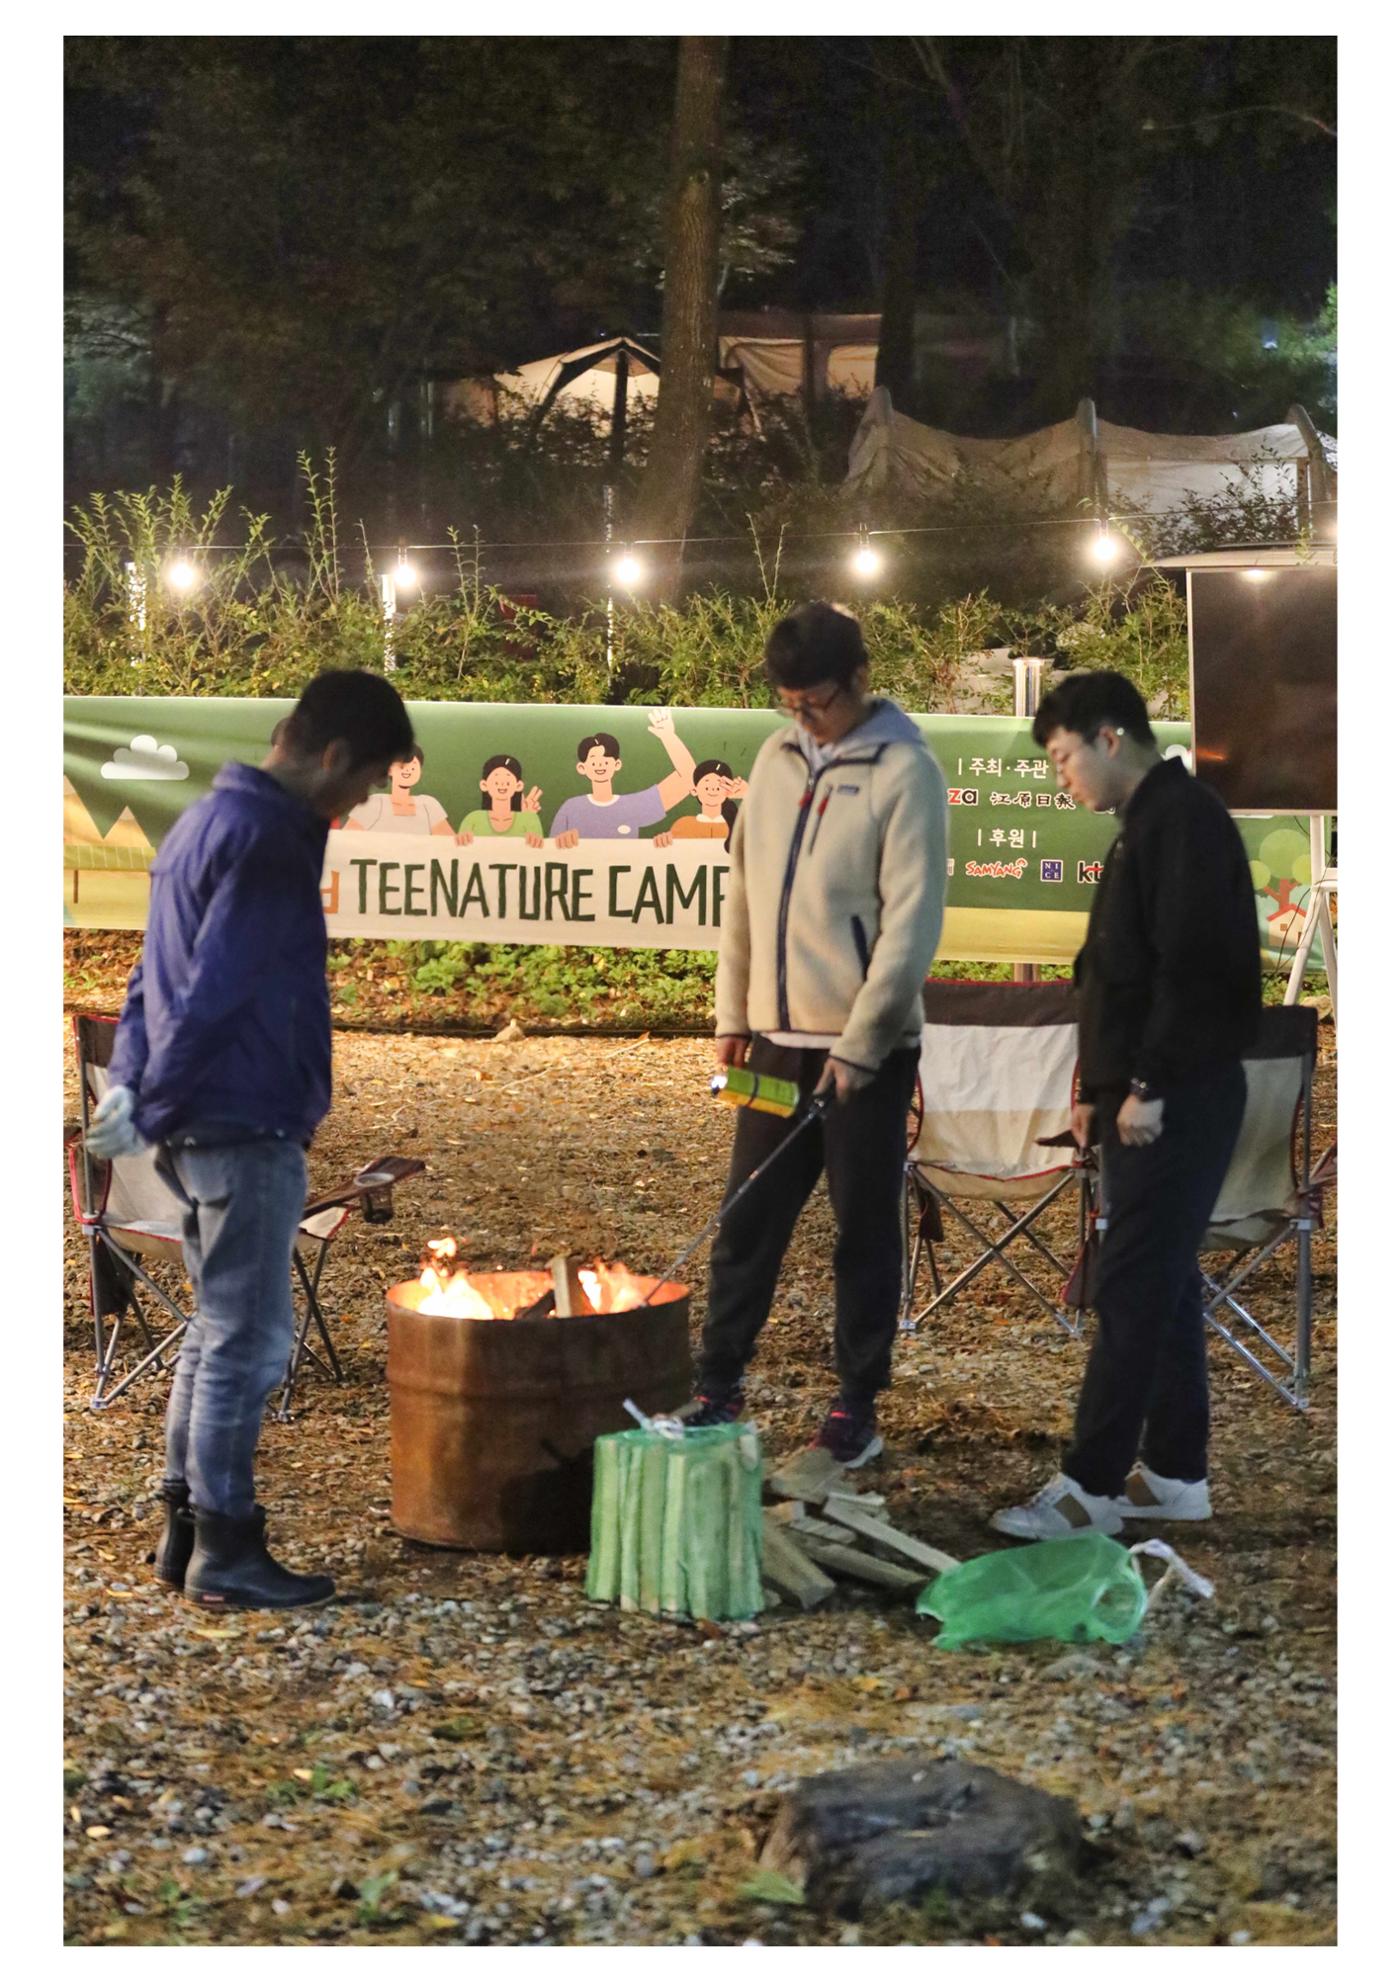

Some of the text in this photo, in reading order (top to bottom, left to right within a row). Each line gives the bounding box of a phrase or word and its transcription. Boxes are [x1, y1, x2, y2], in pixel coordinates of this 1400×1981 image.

[989, 828, 1024, 848] 후원
[965, 860, 1023, 879] SAMYANG
[350, 858, 596, 923] TEENATURE
